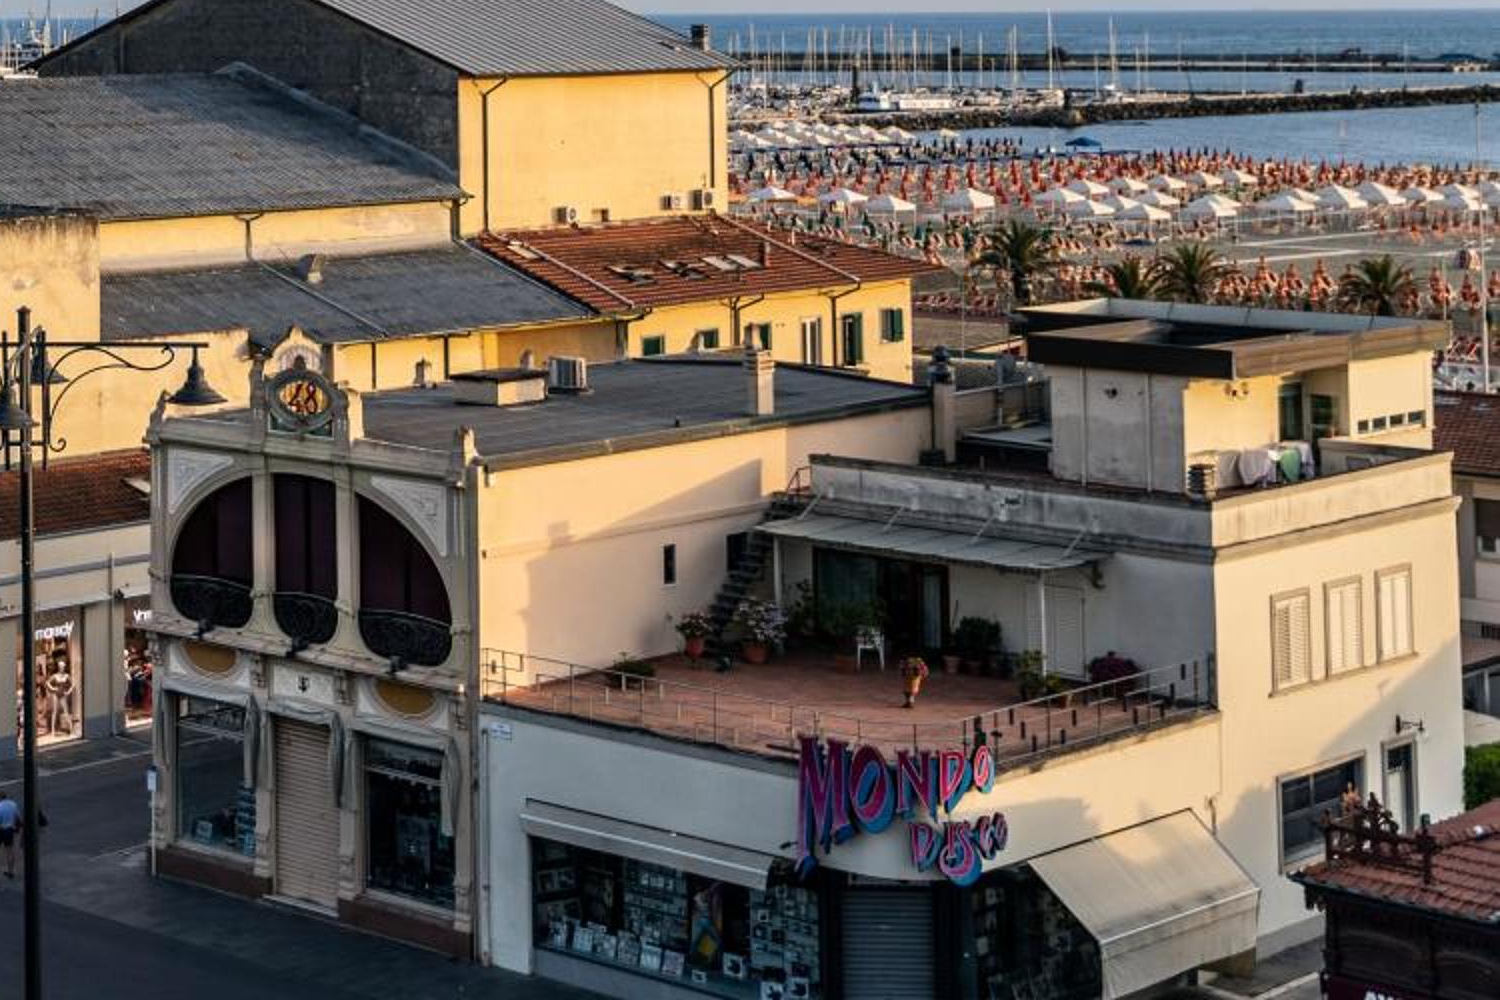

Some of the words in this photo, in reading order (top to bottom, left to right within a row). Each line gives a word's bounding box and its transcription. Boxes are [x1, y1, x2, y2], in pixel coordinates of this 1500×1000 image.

[288, 380, 318, 415] 48
[795, 736, 995, 876] MONDO
[911, 812, 1008, 887] DISCO
